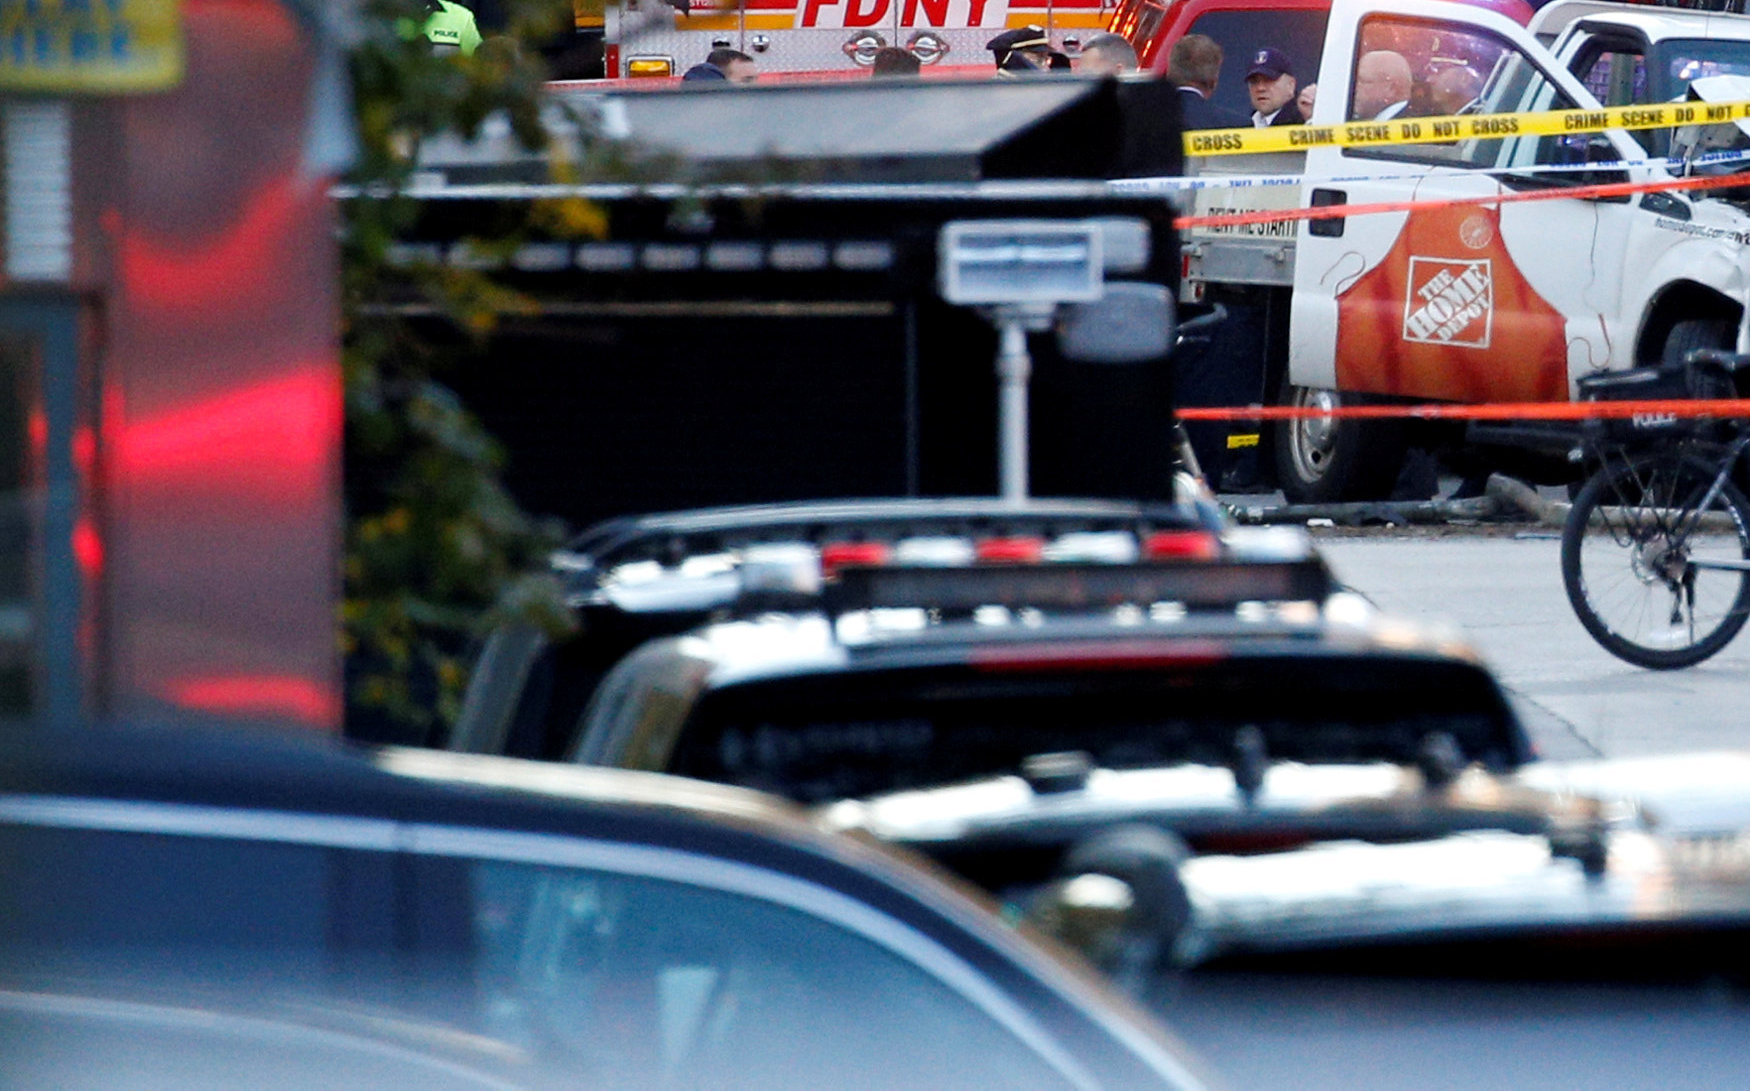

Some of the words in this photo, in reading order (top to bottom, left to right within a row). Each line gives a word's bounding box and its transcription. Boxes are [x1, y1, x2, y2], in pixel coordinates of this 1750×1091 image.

[433, 29, 459, 39] POLICE
[1289, 128, 1335, 145] CRIME
[1346, 124, 1390, 141] SCENE
[1401, 123, 1421, 139] DO
[1433, 120, 1460, 137] NOT
[1472, 117, 1520, 134] CROSS
[1564, 112, 1609, 130] CRIME
[1621, 109, 1664, 126] SCENE
[1675, 107, 1695, 122] DO
[1706, 104, 1733, 121] NOT
[1192, 133, 1243, 151] CROSS
[1417, 269, 1454, 301] THE
[1405, 263, 1490, 340] HOME
[1437, 293, 1490, 342] DEPOT
